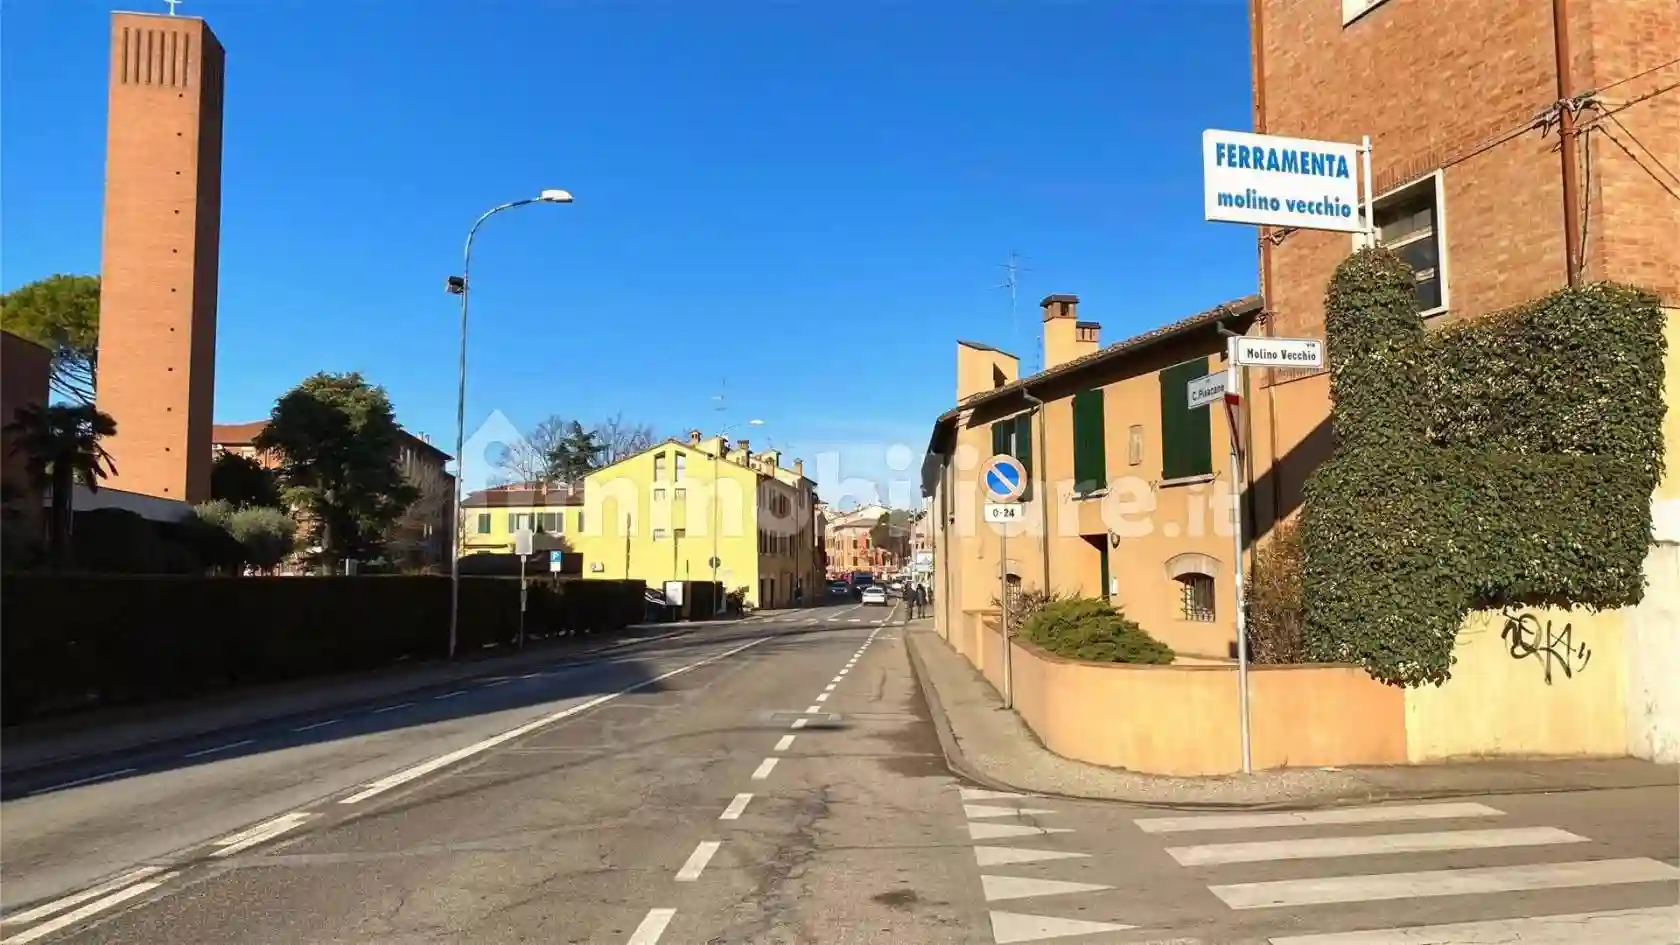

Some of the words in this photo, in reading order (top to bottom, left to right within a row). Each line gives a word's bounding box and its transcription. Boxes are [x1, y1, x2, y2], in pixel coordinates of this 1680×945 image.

[1215, 142, 1350, 179] FERRAMENTA
[1217, 188, 1281, 212] molino
[1285, 195, 1352, 219] vecchio
[1247, 348, 1278, 360] Molino
[1280, 349, 1316, 361] Vecchio
